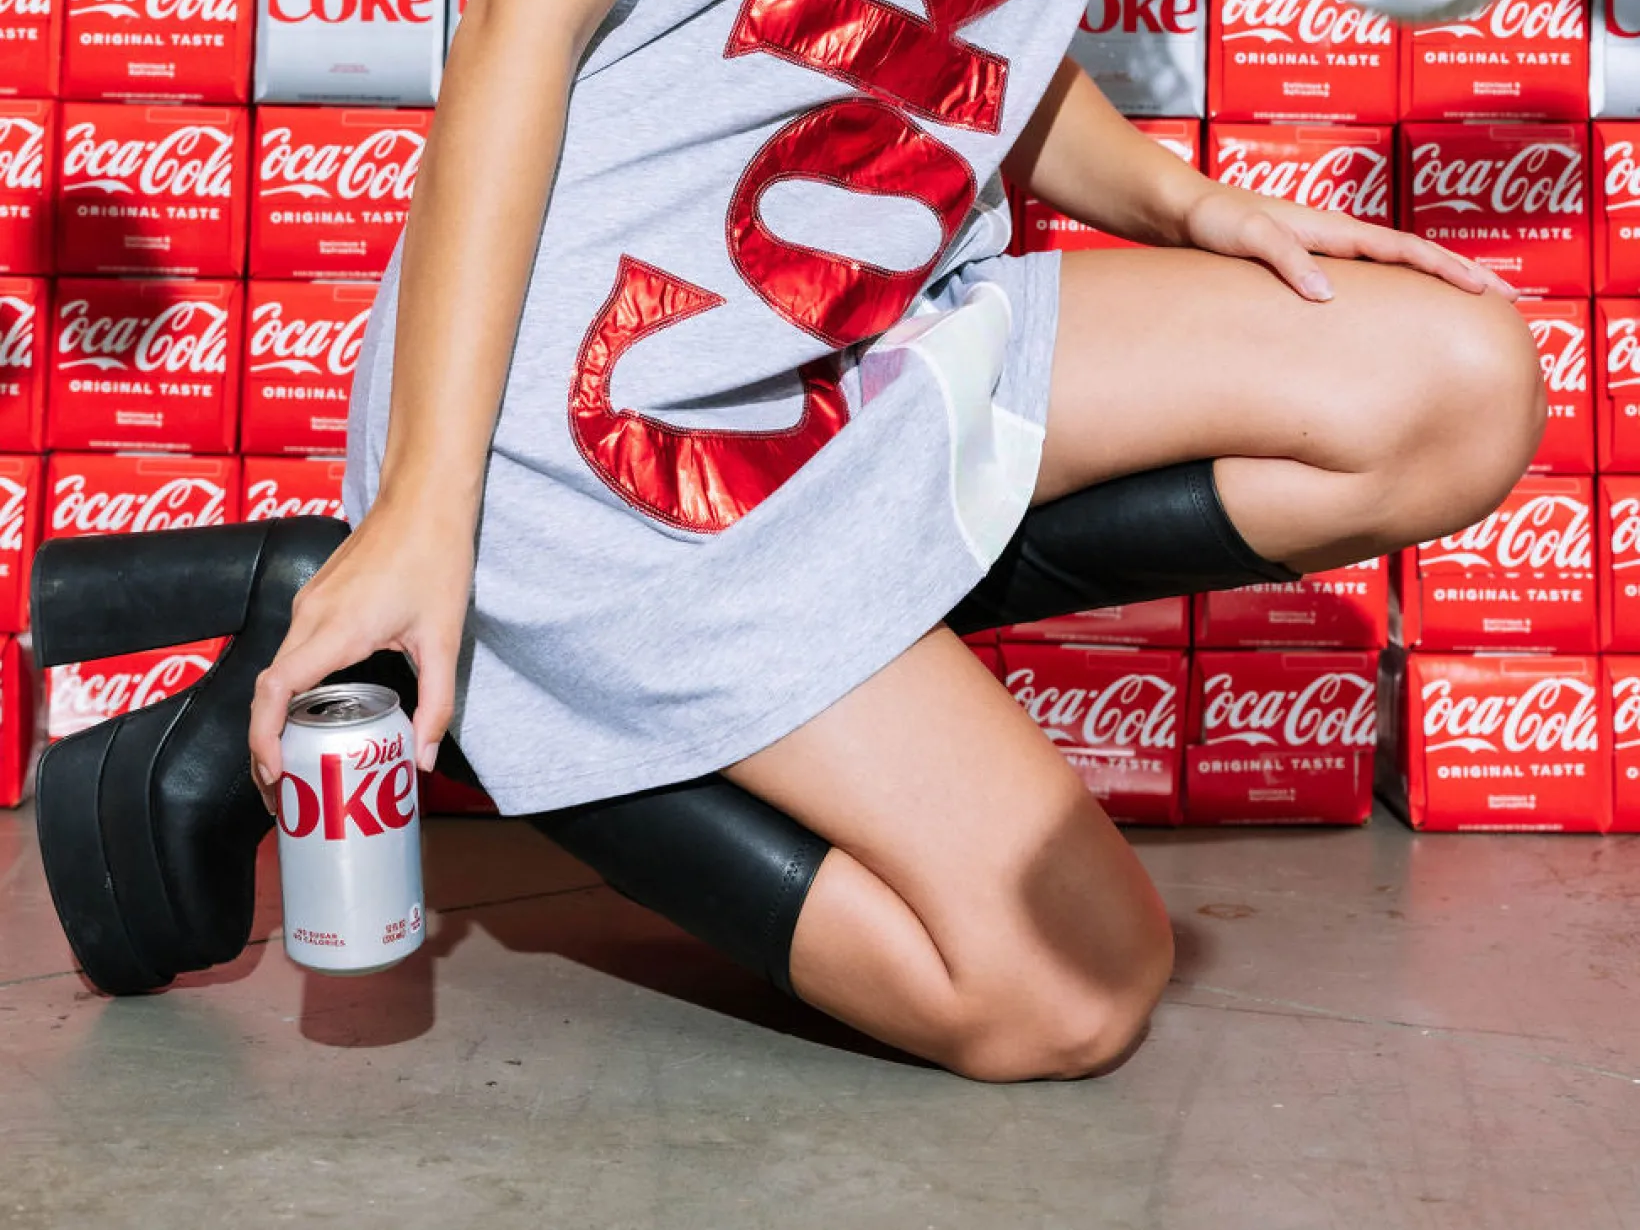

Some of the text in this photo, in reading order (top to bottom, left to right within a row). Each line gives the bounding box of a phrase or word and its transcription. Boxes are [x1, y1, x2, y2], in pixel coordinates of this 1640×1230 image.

[81, 35, 224, 46] ORIGINAL TASTE
[1235, 52, 1379, 65] ORIGINAL TASTE
[1425, 52, 1570, 65] ORIGINAL TASTE
[77, 207, 219, 220] ORIGINAL TASTE
[271, 212, 354, 224] ORIGINAL
[1426, 228, 1572, 240] ORIGINAL TASTE
[251, 302, 368, 374] oca-C
[69, 381, 212, 394] ORIGINAL TASTE
[263, 388, 347, 399] ORIGINAL
[1421, 496, 1591, 569] a-Cola
[1234, 581, 1367, 595] IGINAL TASTE
[1434, 589, 1582, 602] ORIGINAL TASTE
[347, 732, 403, 770] Diet
[1108, 758, 1163, 771] TASTE
[1199, 758, 1345, 773] ORIGINAL TASTE
[1437, 765, 1585, 779] ORIGINAL TASTE
[277, 753, 415, 841] oke
